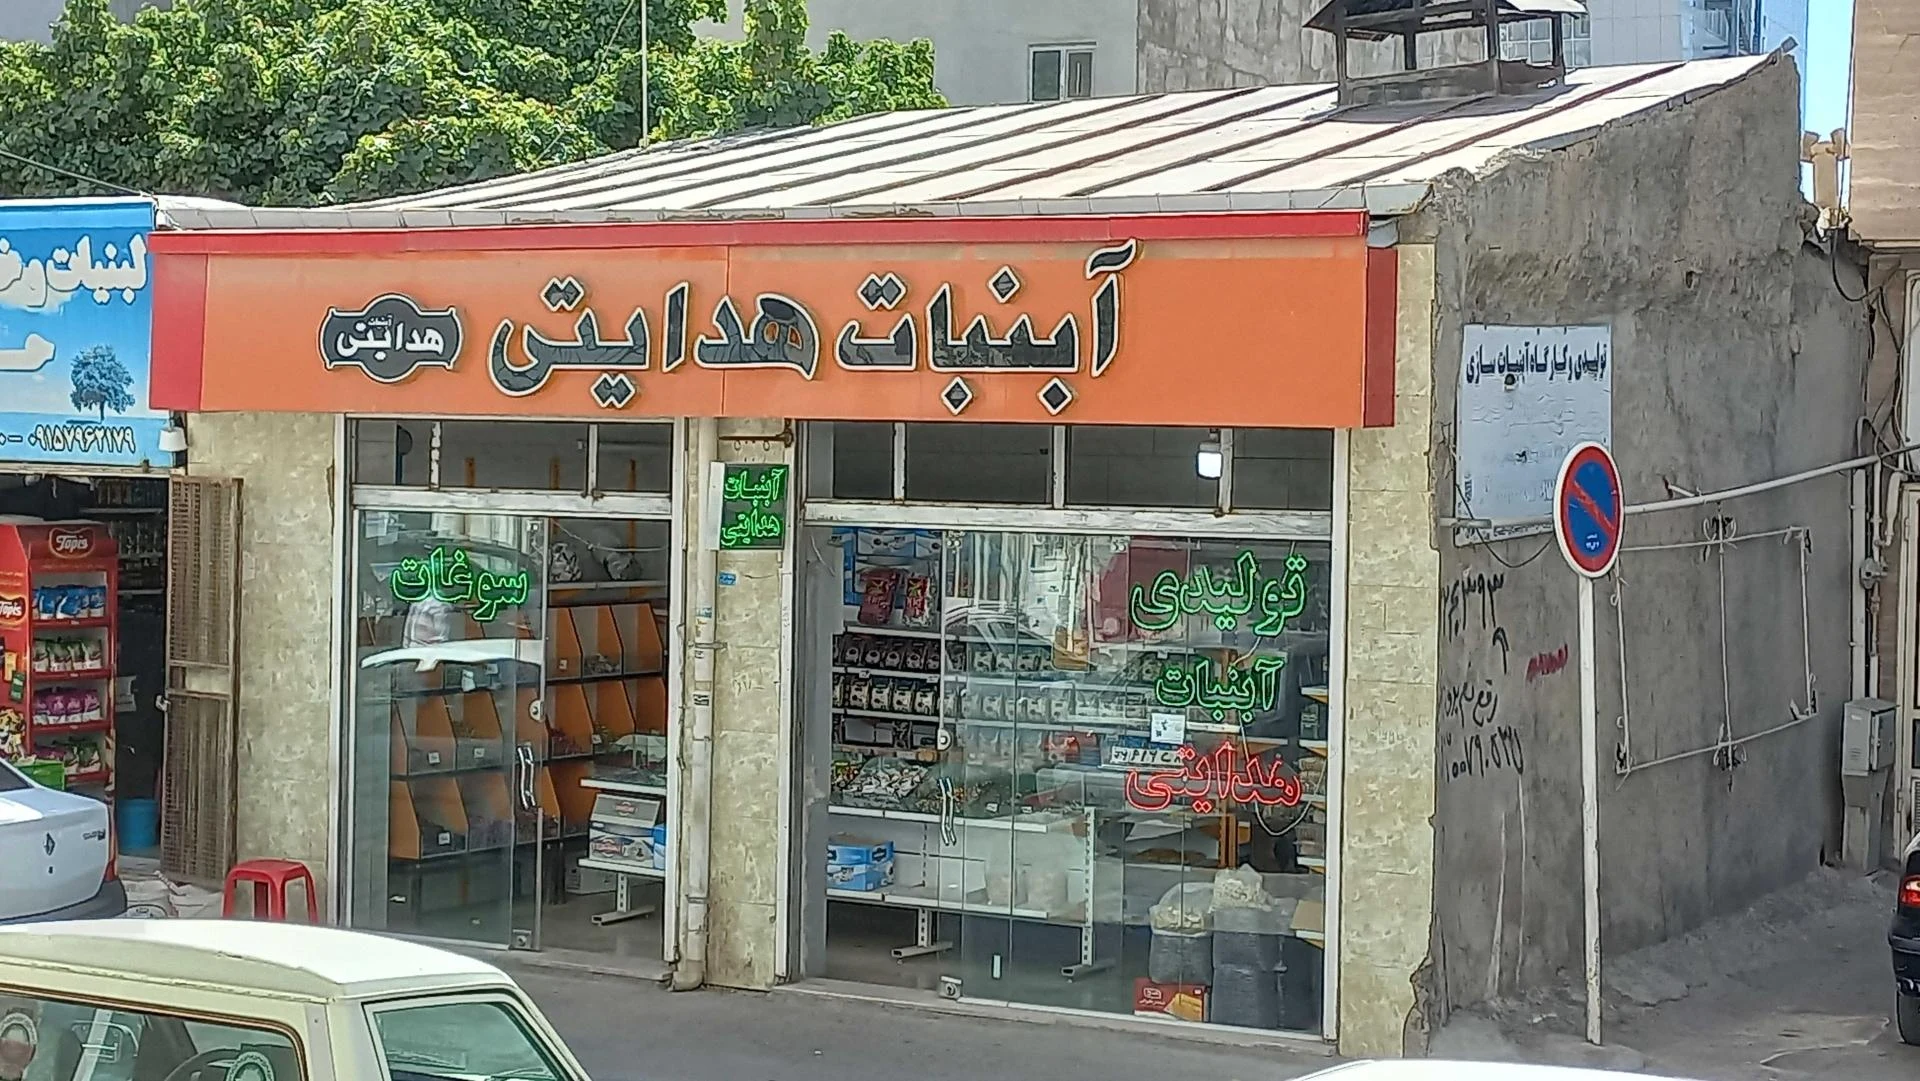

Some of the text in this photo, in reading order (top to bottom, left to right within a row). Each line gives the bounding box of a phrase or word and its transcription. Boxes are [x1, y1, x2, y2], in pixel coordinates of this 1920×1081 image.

[45, 233, 148, 305] لبنیات
[336, 322, 445, 361] هدایتی
[487, 237, 1138, 416] آبنبات هدایتی
[724, 468, 785, 507] آبنبات
[720, 508, 780, 546] هدایتی
[392, 547, 528, 621] سوغات
[1131, 551, 1307, 636] تولیدی
[1155, 657, 1284, 722] آبنبات
[1126, 741, 1302, 814] هدایتی
